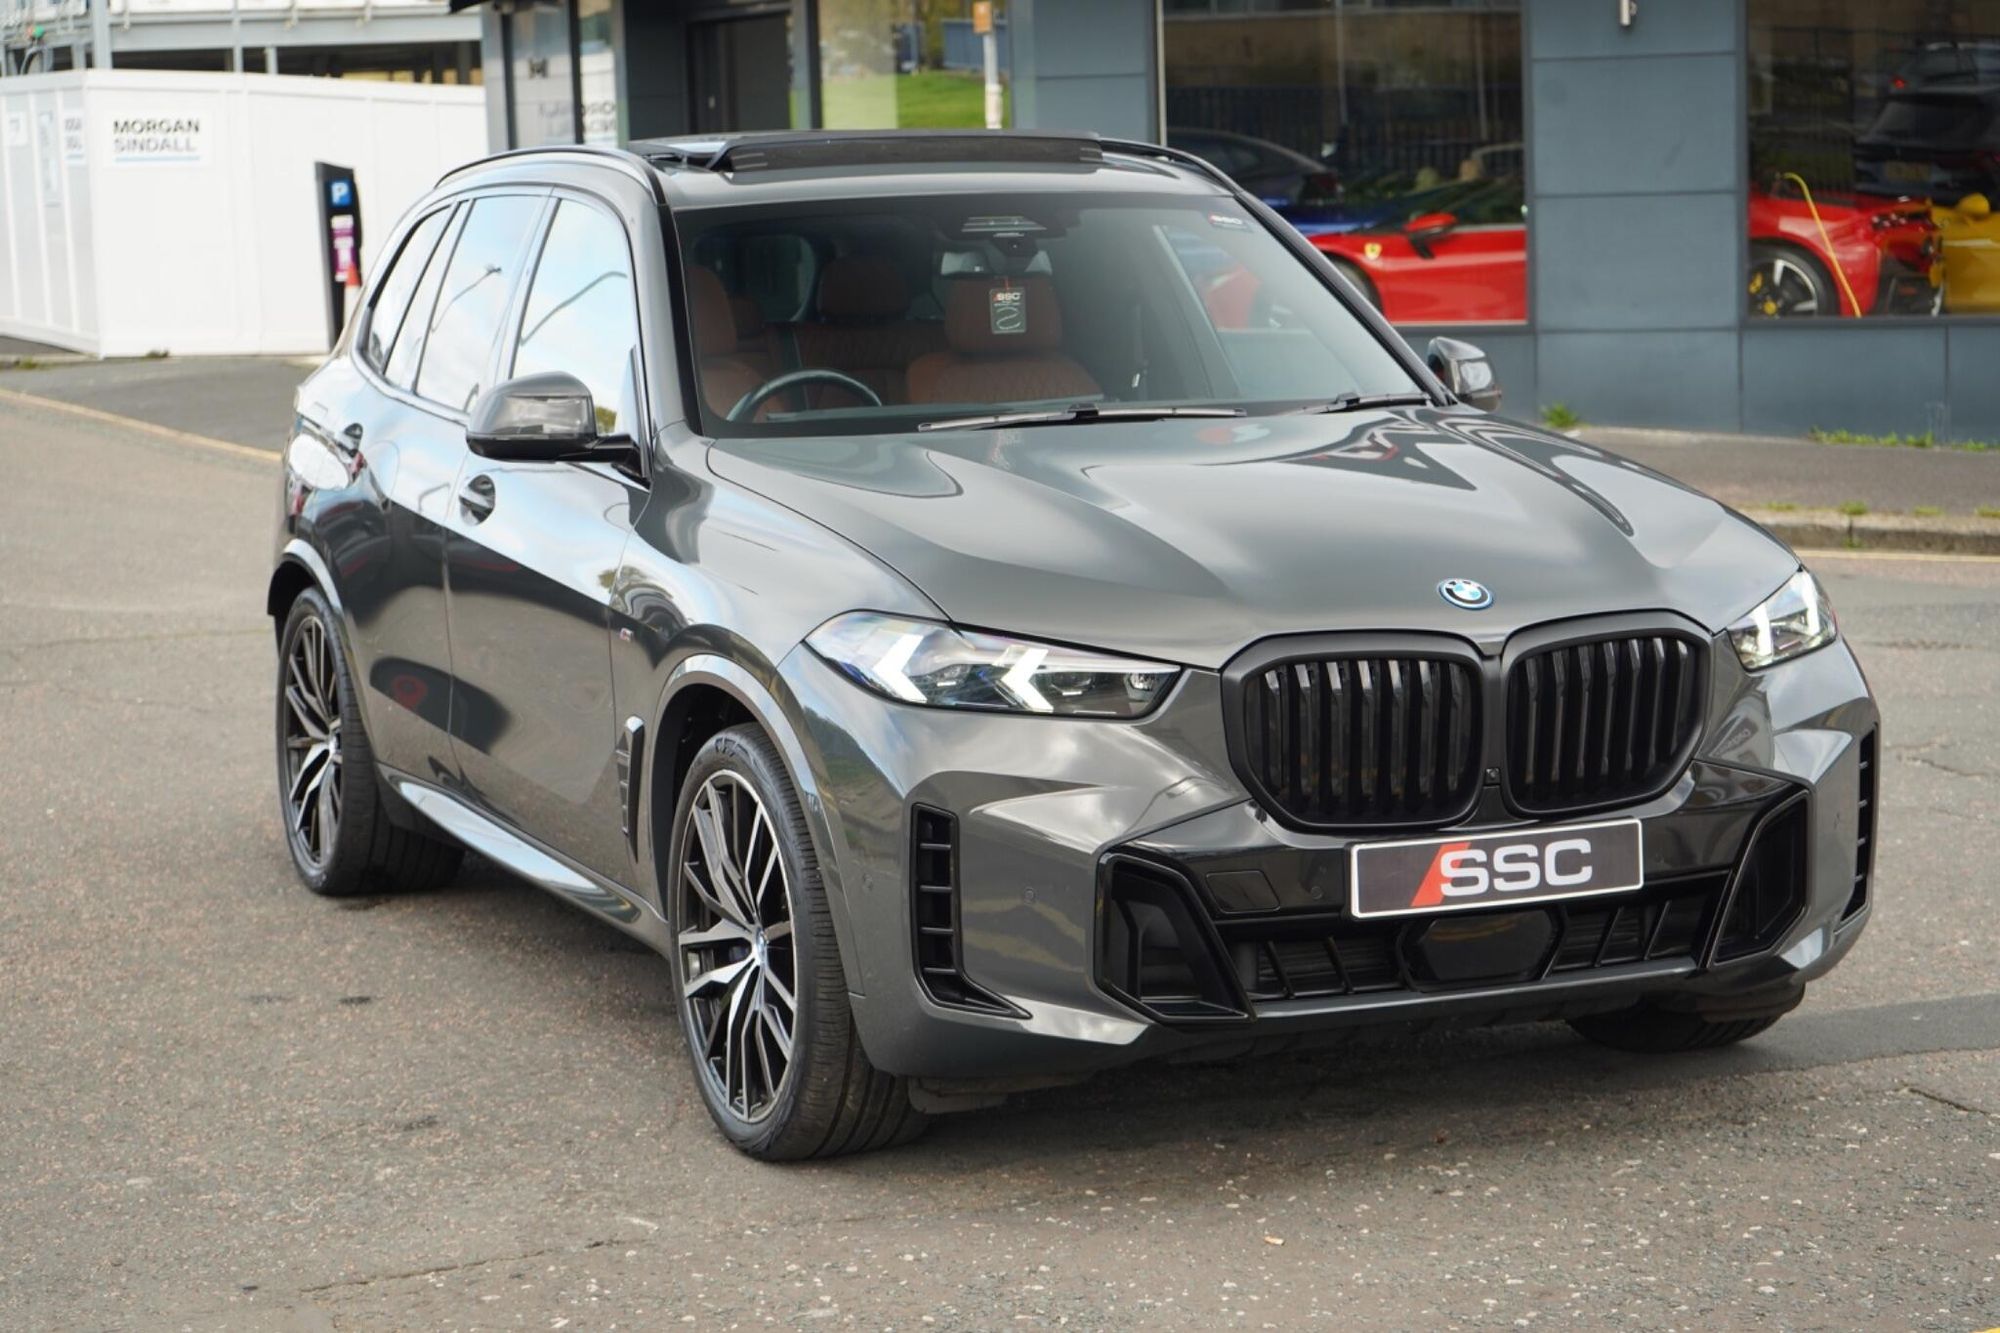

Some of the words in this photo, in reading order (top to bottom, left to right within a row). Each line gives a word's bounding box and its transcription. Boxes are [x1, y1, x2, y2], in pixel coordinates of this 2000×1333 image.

[113, 119, 200, 133] MORGAN
[114, 138, 197, 152] SINDALL
[331, 182, 349, 205] P
[1440, 838, 1593, 896] SSC
